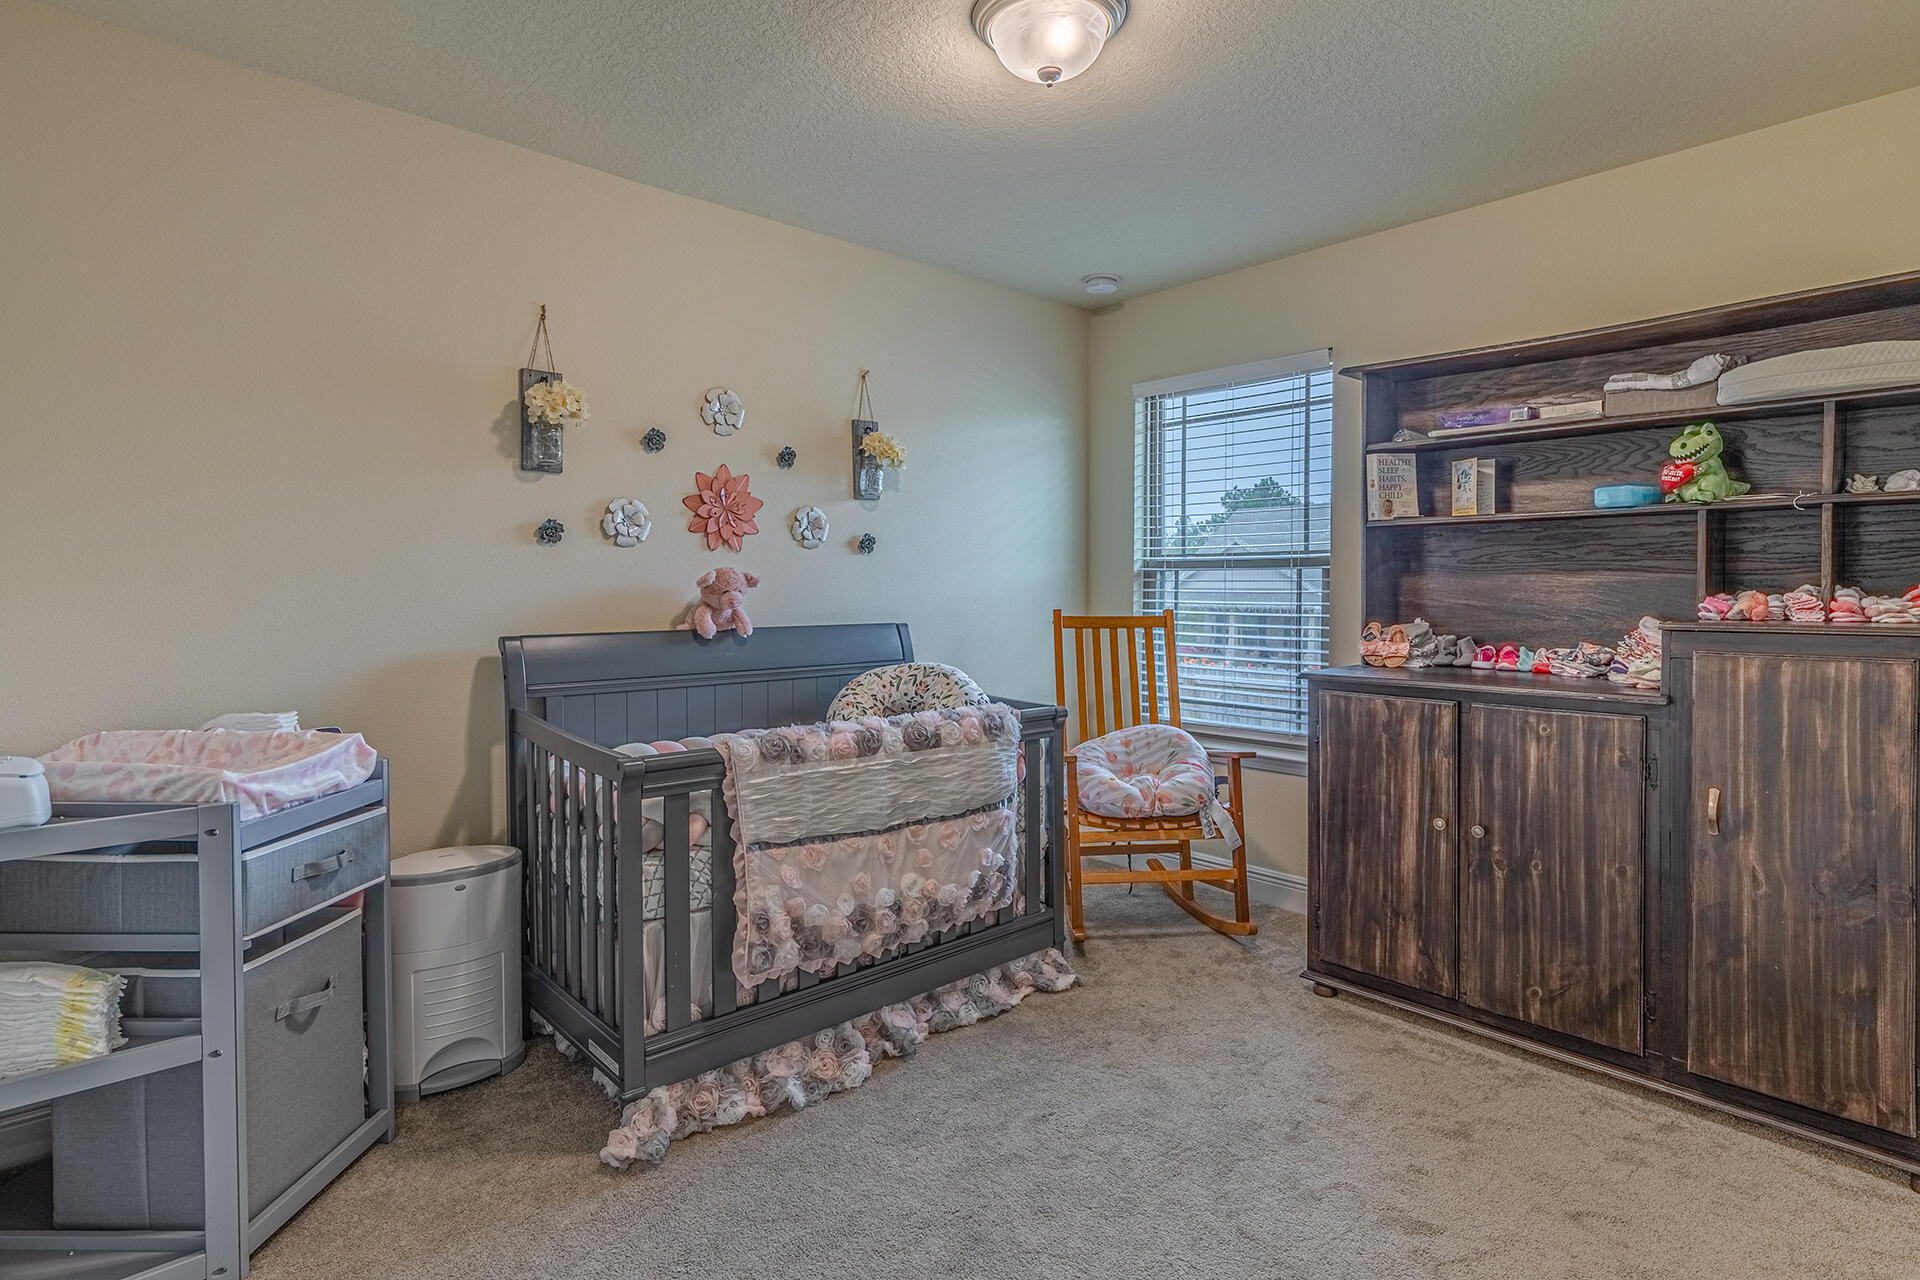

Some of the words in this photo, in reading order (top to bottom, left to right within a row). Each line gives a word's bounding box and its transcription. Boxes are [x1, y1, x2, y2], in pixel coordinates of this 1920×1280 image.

[1378, 458, 1413, 466] HEALTHY
[1378, 466, 1400, 474] SLEEP
[1378, 474, 1407, 483] HABITS,
[1378, 483, 1403, 491] HAPPY
[1378, 491, 1403, 499] CHILD
